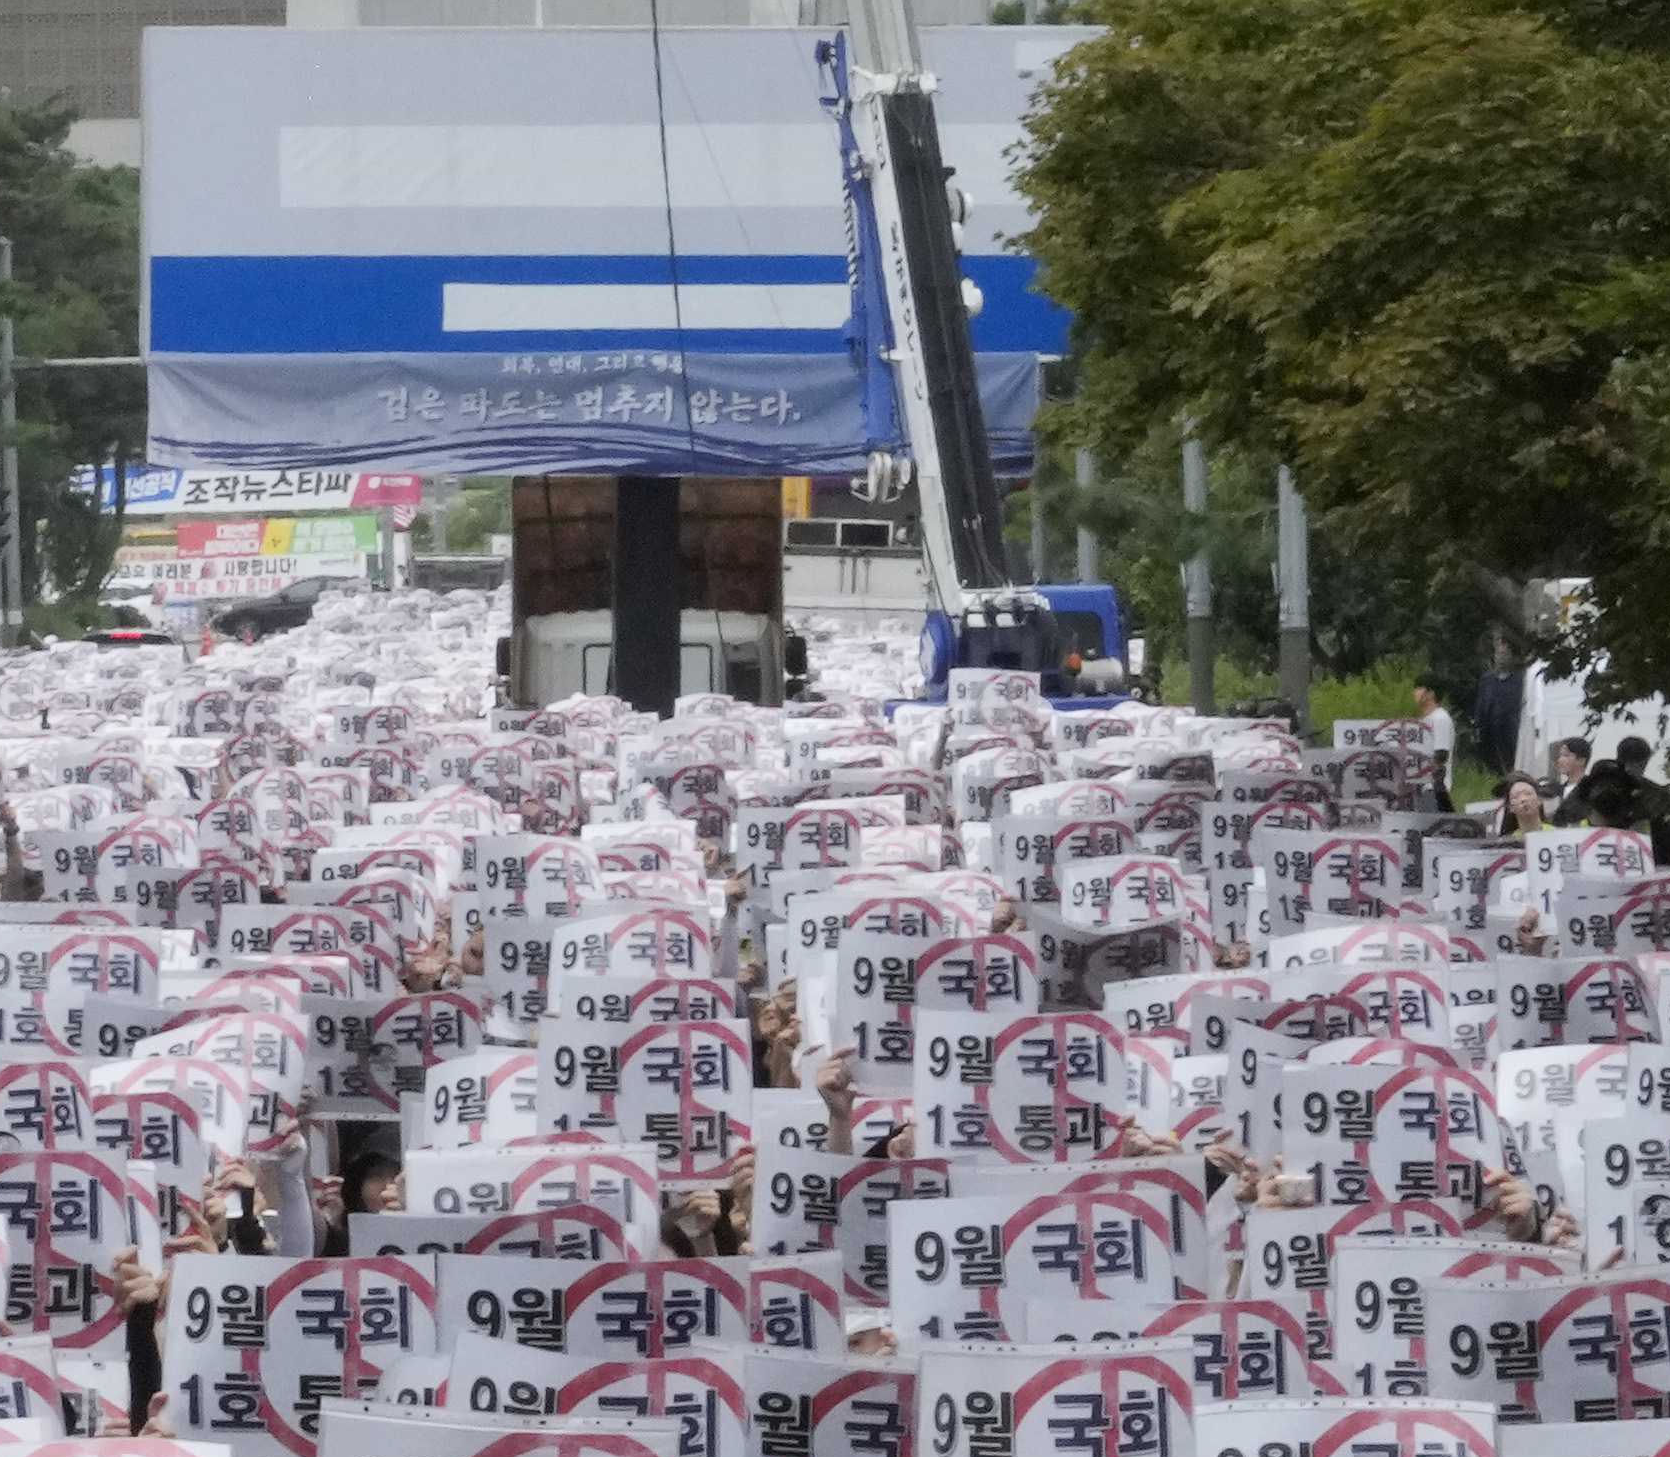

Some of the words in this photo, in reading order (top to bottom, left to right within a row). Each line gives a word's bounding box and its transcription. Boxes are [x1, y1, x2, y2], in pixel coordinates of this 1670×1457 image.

[378, 386, 446, 423] 검은
[461, 388, 563, 423] 파도는
[573, 384, 674, 423] 멈추지
[690, 389, 803, 426] 않는다.
[184, 469, 352, 505] 조작뉴스타파
[68, 952, 142, 995] 국회
[553, 1046, 620, 1093] 9월
[644, 1044, 729, 1092] 국회
[928, 1036, 995, 1083] 9월
[1017, 1032, 1108, 1083] 국회
[929, 1105, 989, 1145] 1호
[1017, 1104, 1105, 1153] 통과
[1304, 1091, 1373, 1135] 9월
[1400, 1092, 1481, 1138] 국회
[914, 1223, 1004, 1289] 9월
[1033, 1217, 1149, 1289] 국회
